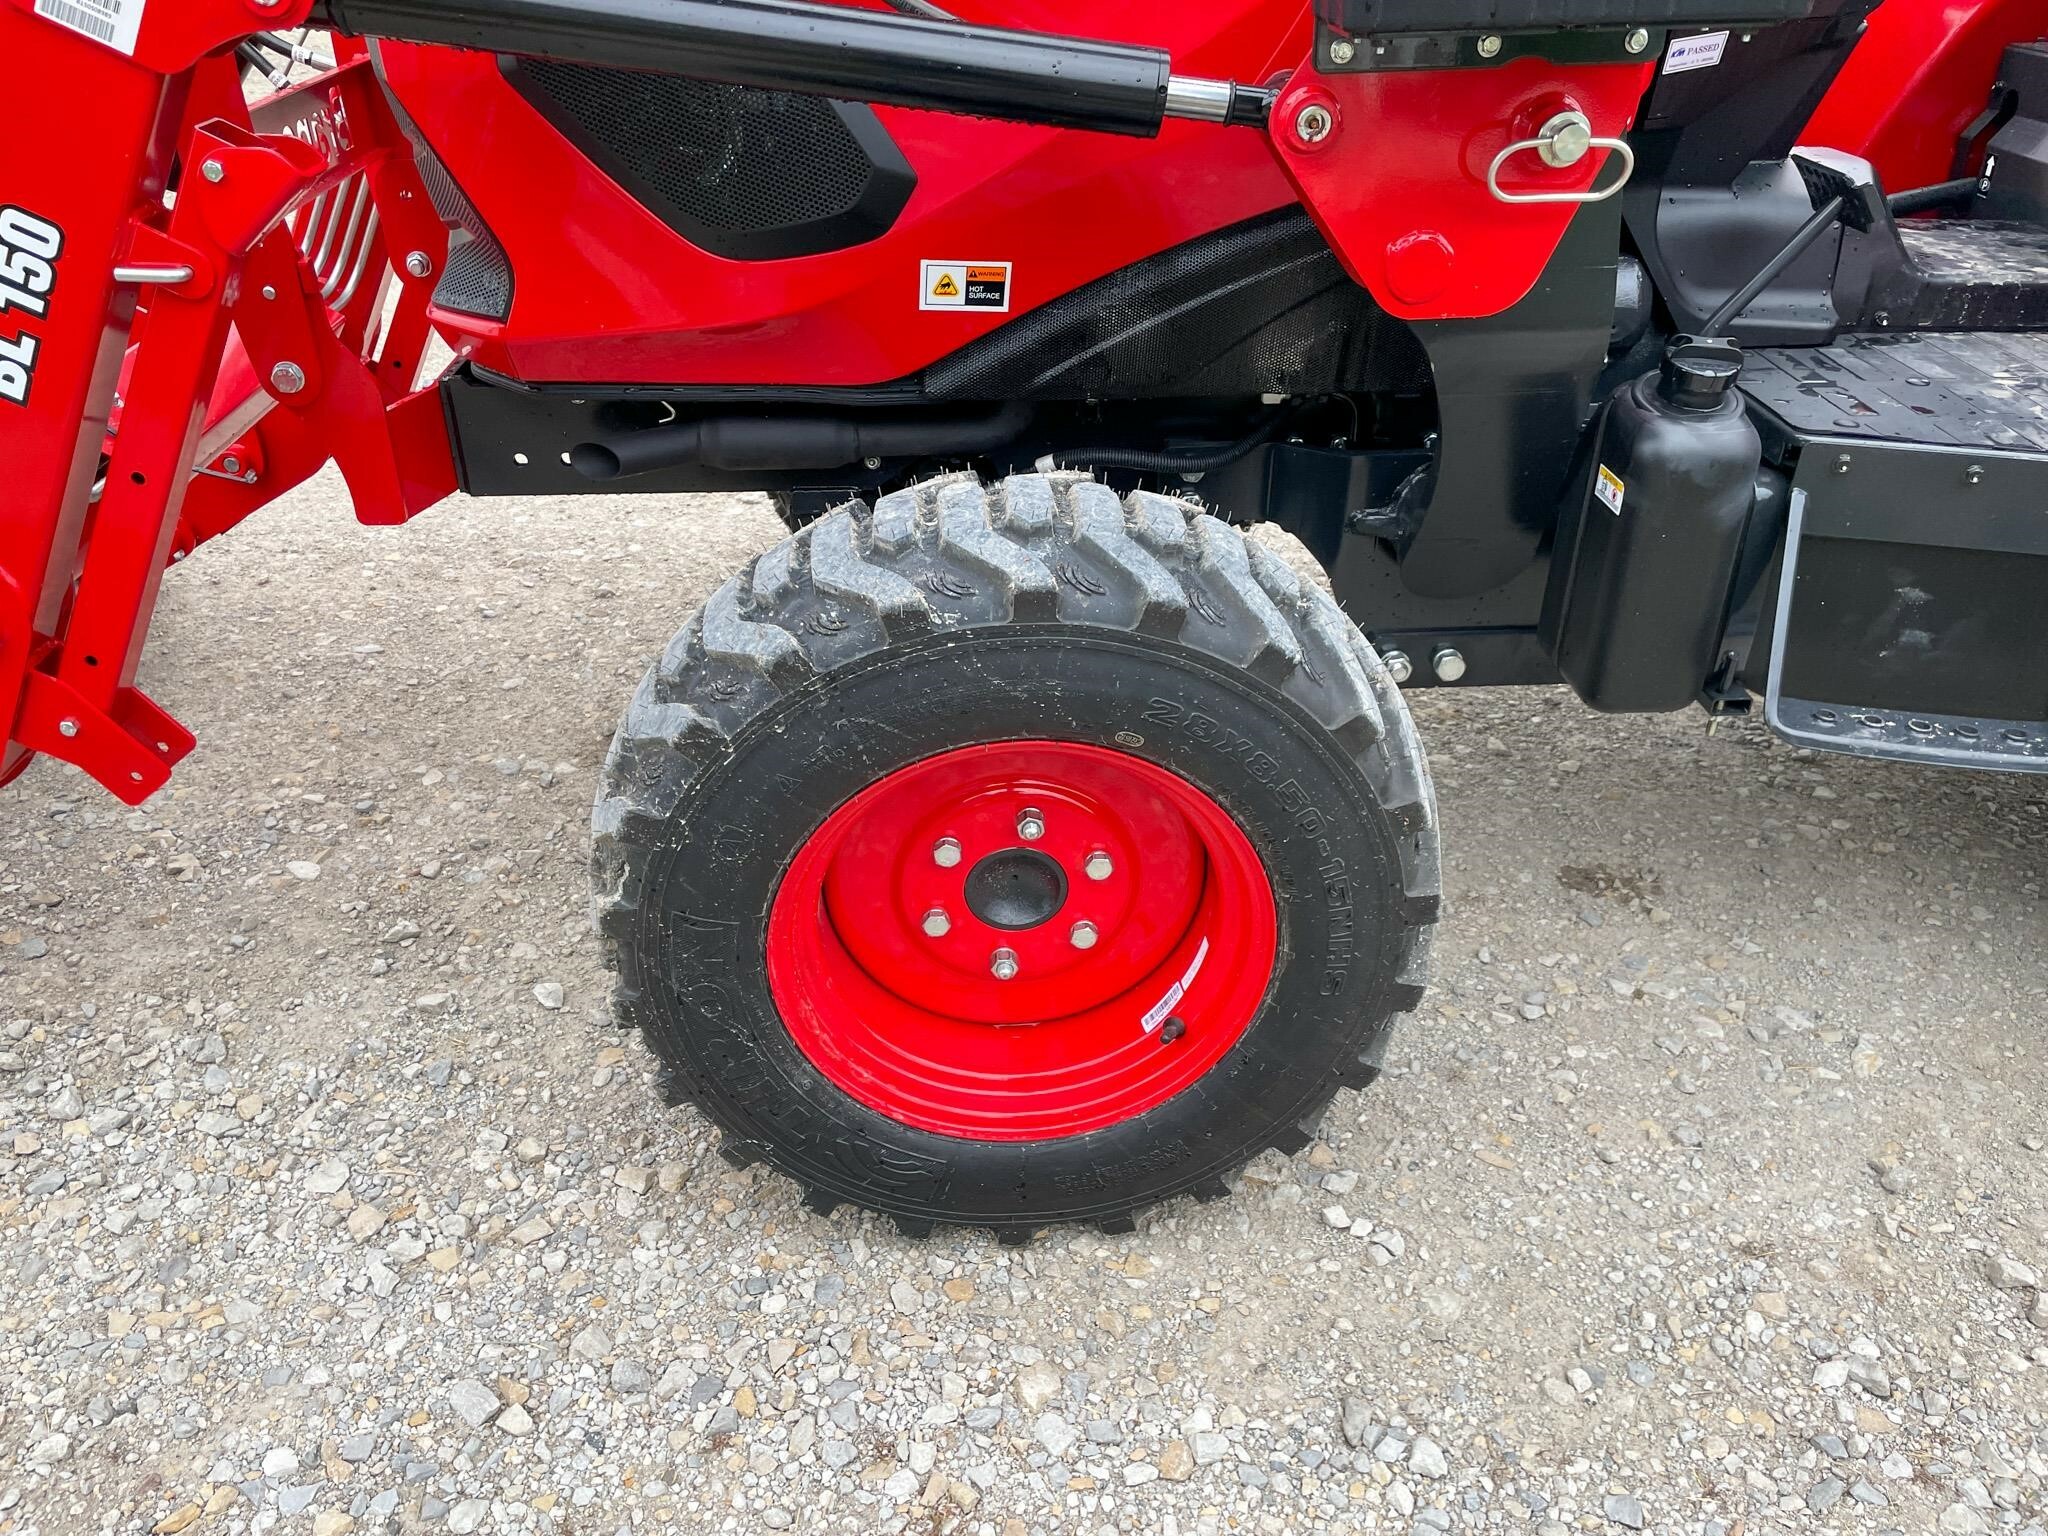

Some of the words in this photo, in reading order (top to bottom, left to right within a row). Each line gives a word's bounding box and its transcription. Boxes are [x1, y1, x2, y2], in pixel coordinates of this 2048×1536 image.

[1687, 43, 1720, 55] PASSED
[0, 205, 64, 319] 150
[969, 292, 1000, 300] SURFACE
